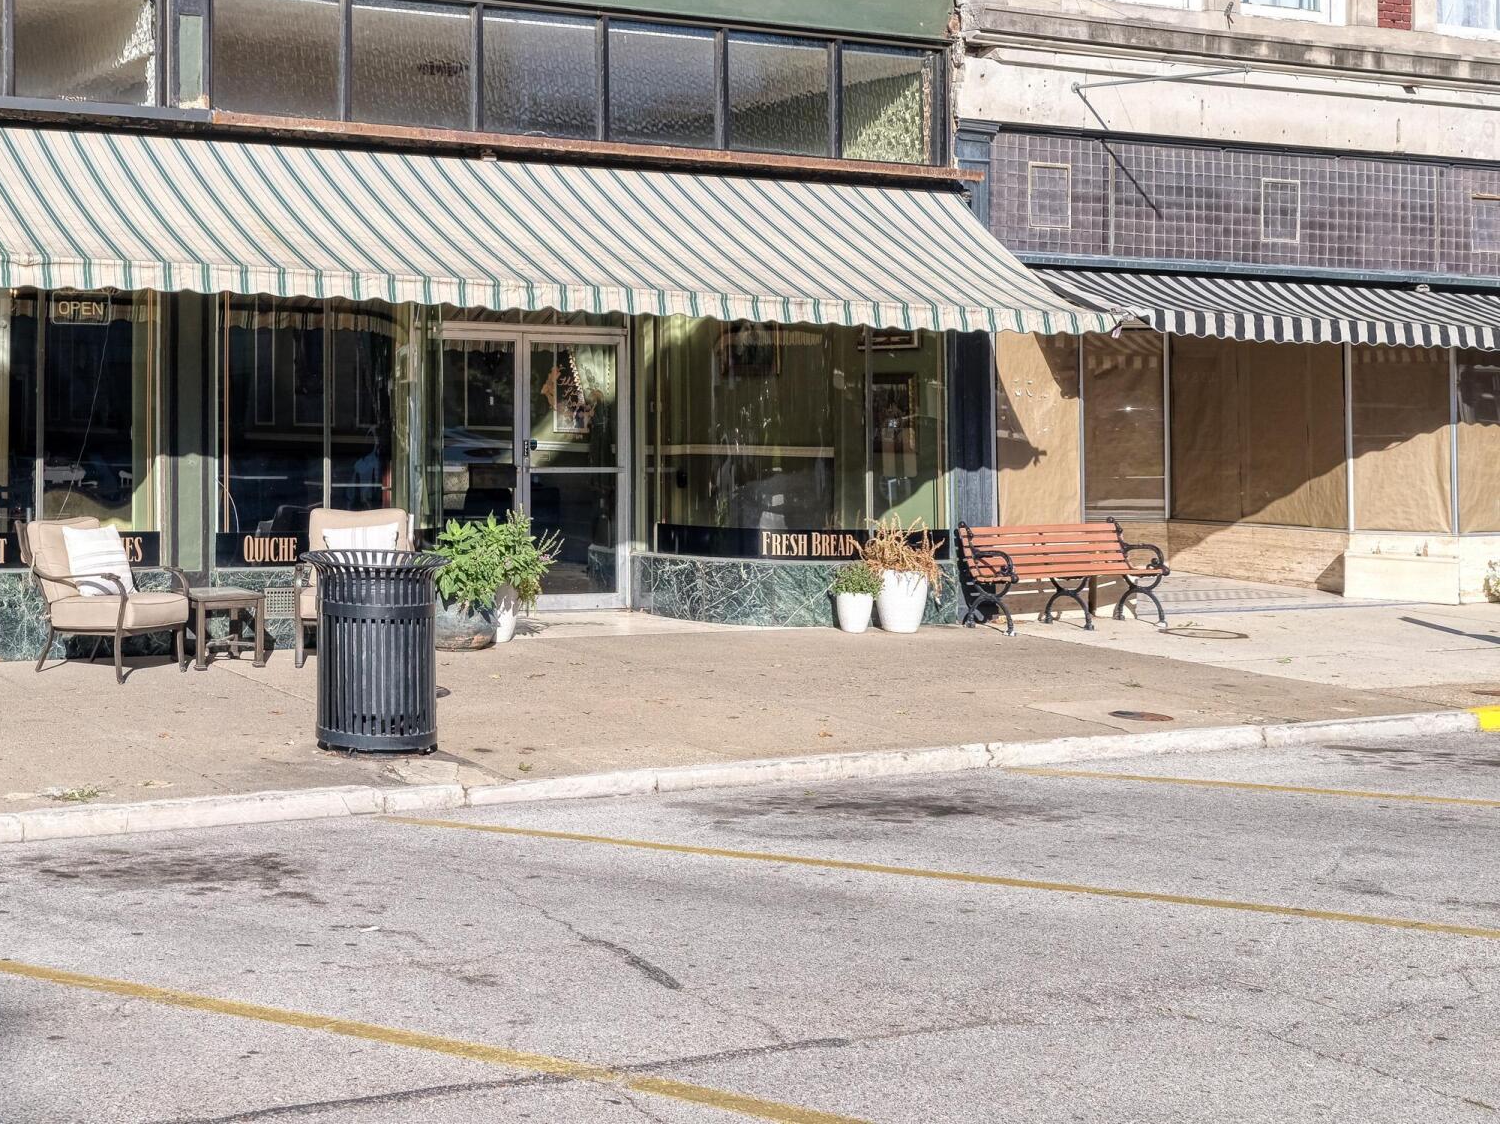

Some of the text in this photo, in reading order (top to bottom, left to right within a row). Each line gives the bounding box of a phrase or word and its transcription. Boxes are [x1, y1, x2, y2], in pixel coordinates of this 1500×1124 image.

[59, 301, 104, 315] OPEN
[244, 535, 297, 562] QUICHE
[762, 531, 854, 556] FRESH BREAD
